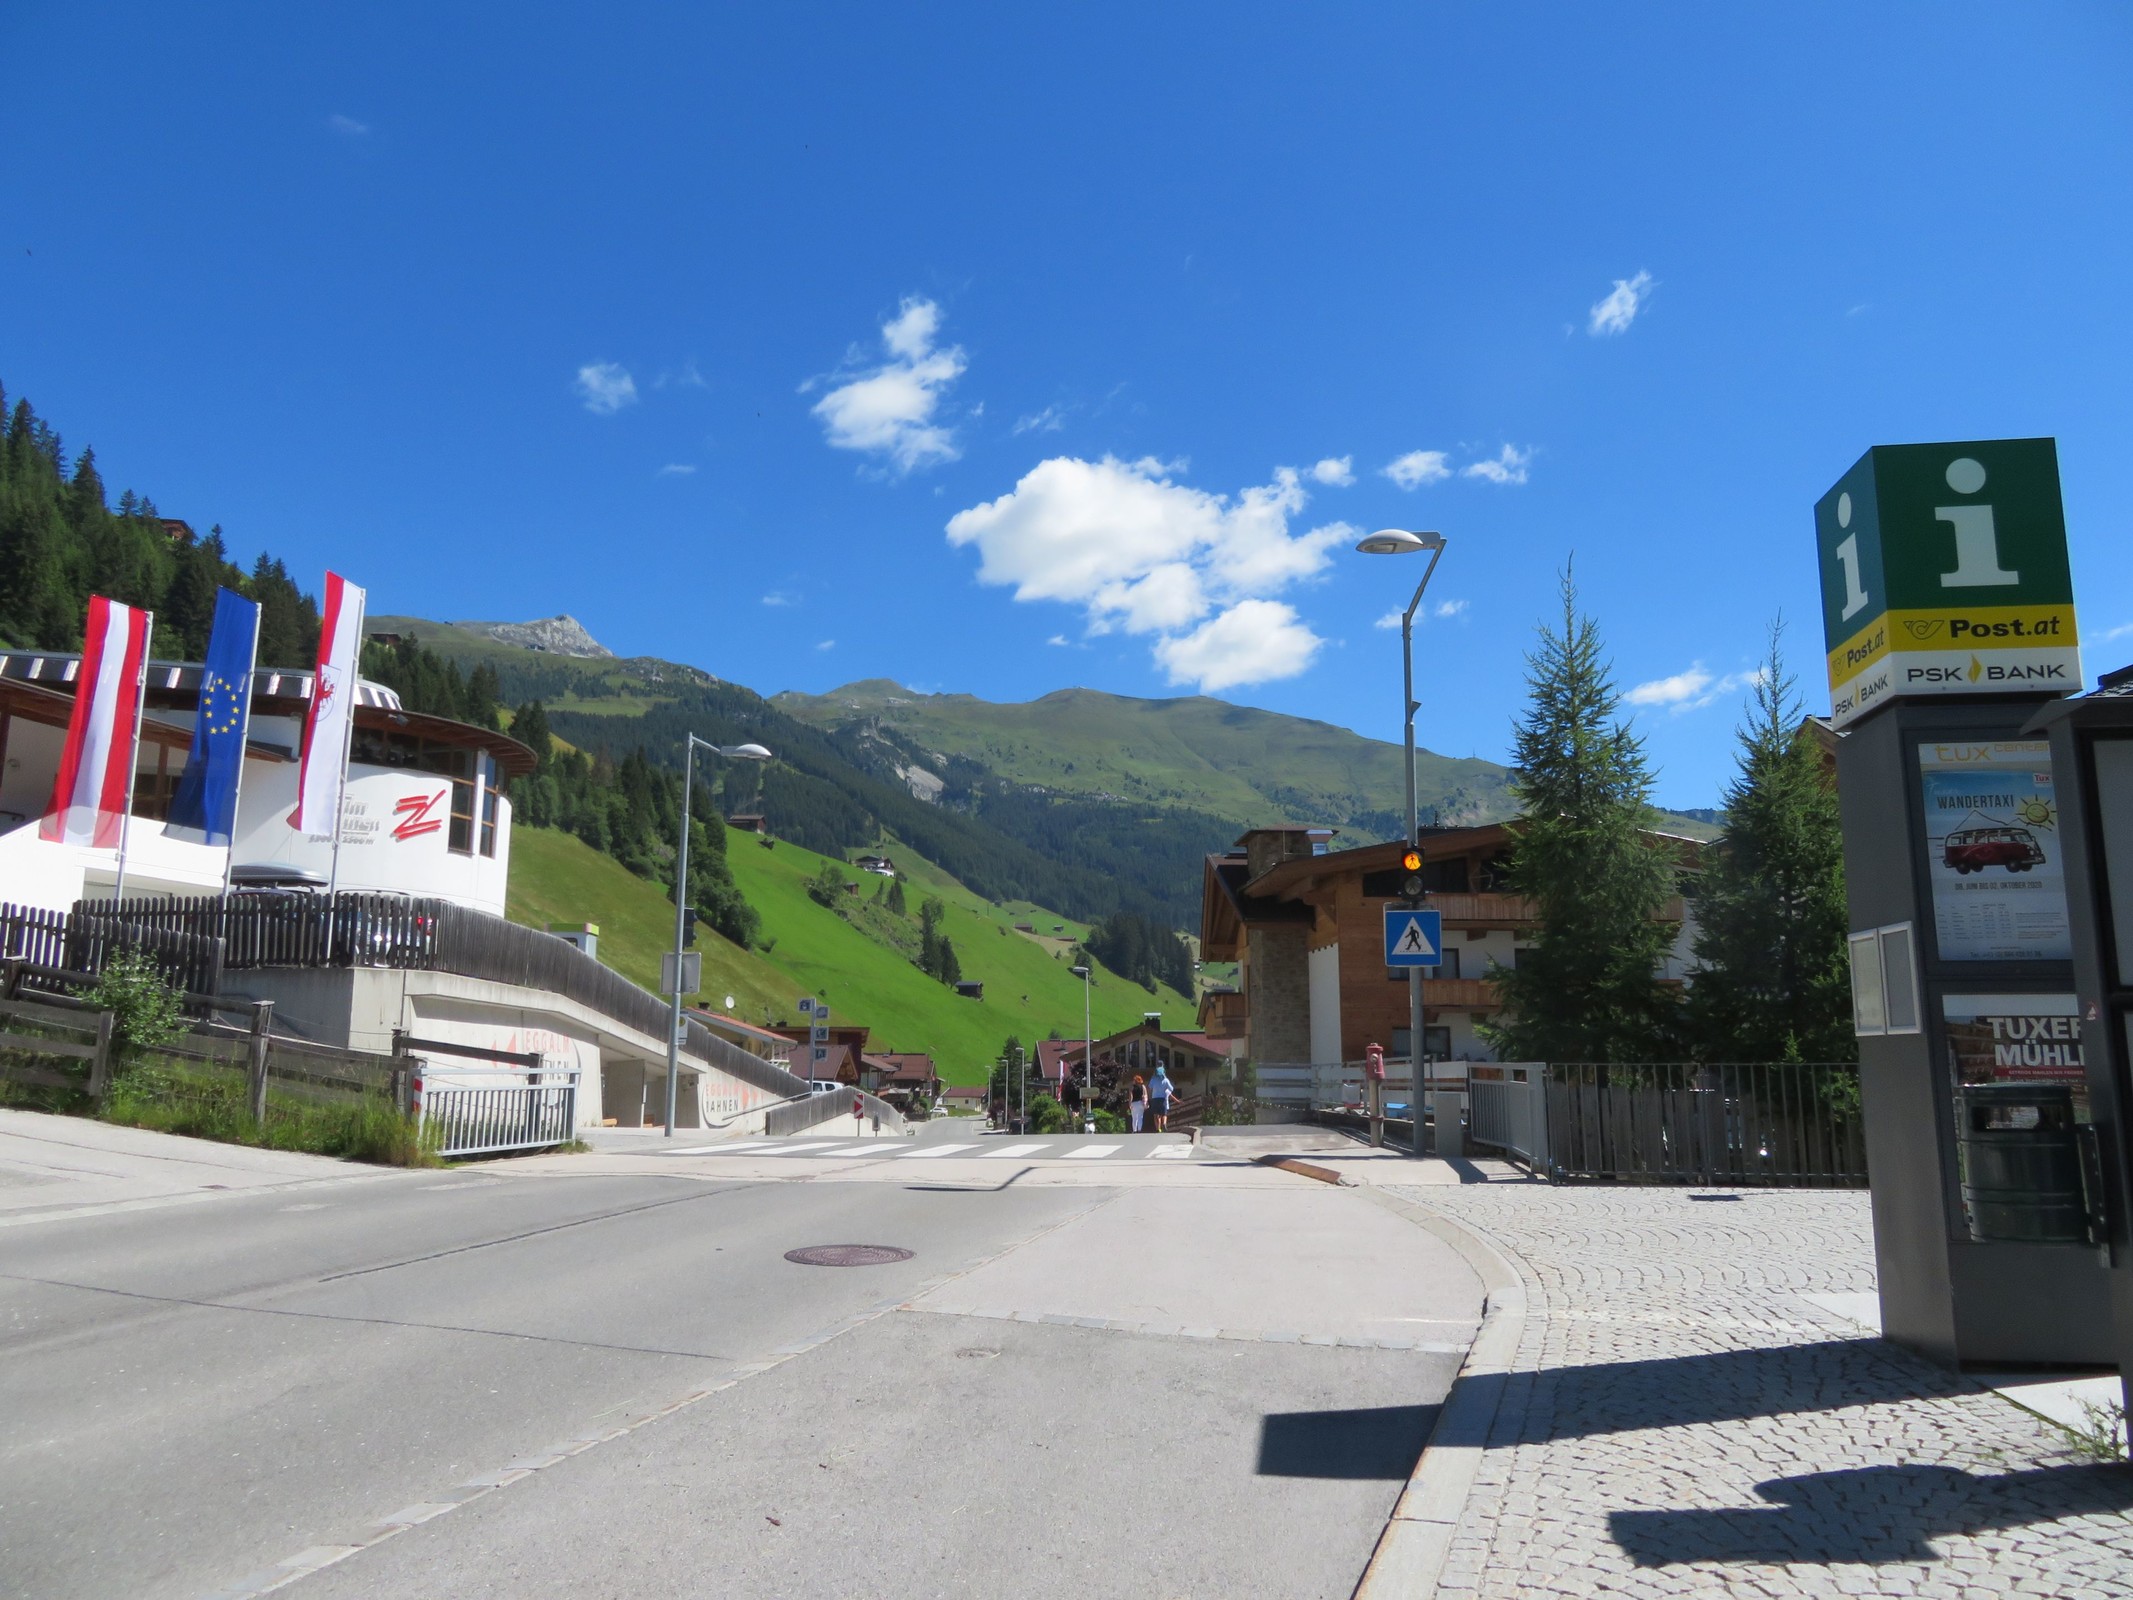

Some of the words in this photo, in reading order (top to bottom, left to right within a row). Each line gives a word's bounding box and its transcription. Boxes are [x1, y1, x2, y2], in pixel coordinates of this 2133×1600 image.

[1950, 616, 2060, 638] Post.at
[1846, 626, 1885, 669] Post.at
[1907, 666, 1963, 682] PSK
[1987, 664, 2066, 681] BANK
[1835, 696, 1854, 718] PSK
[1860, 674, 1888, 703] BANK
[1935, 745, 1991, 762] tux
[2034, 774, 2050, 782] Tux
[1937, 794, 2015, 809] WANDERTAXI
[2000, 881, 2026, 889] OKTOBER
[525, 1030, 570, 1053] EGGALM
